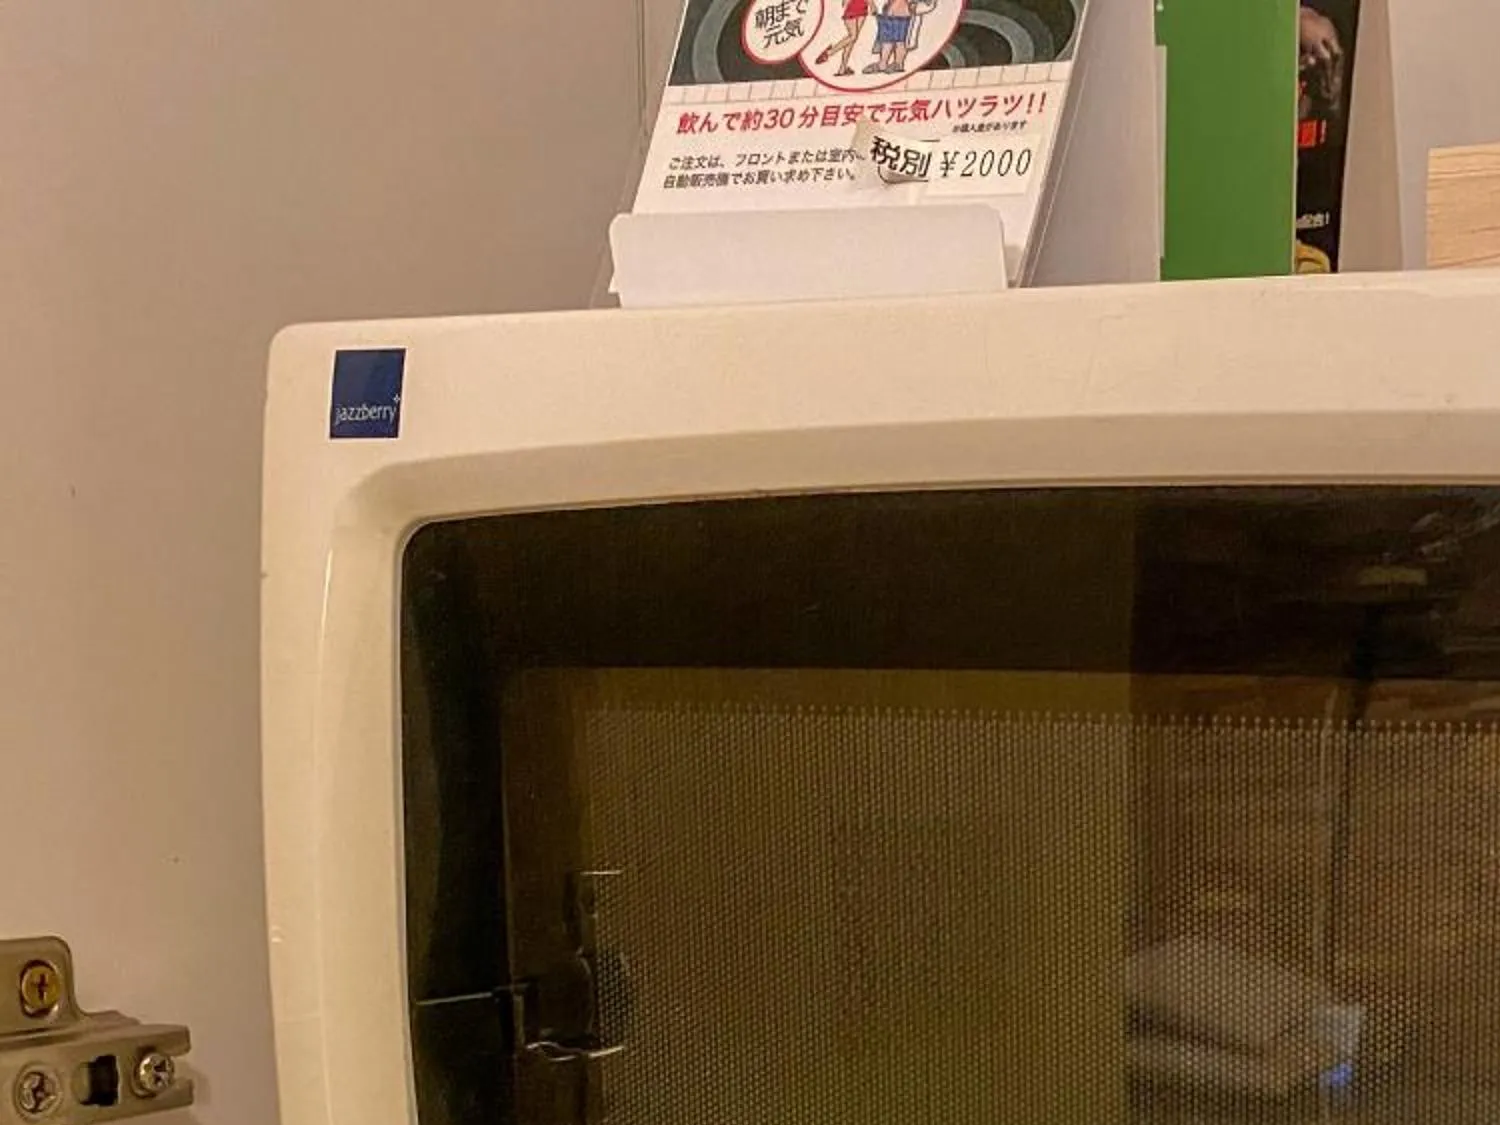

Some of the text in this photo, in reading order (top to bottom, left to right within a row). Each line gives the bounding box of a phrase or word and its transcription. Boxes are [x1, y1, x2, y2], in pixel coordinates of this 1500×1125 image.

[763, 18, 804, 48] 元気
[870, 135, 1031, 178] 税別 ¥2000
[335, 402, 397, 426] jazzberry
